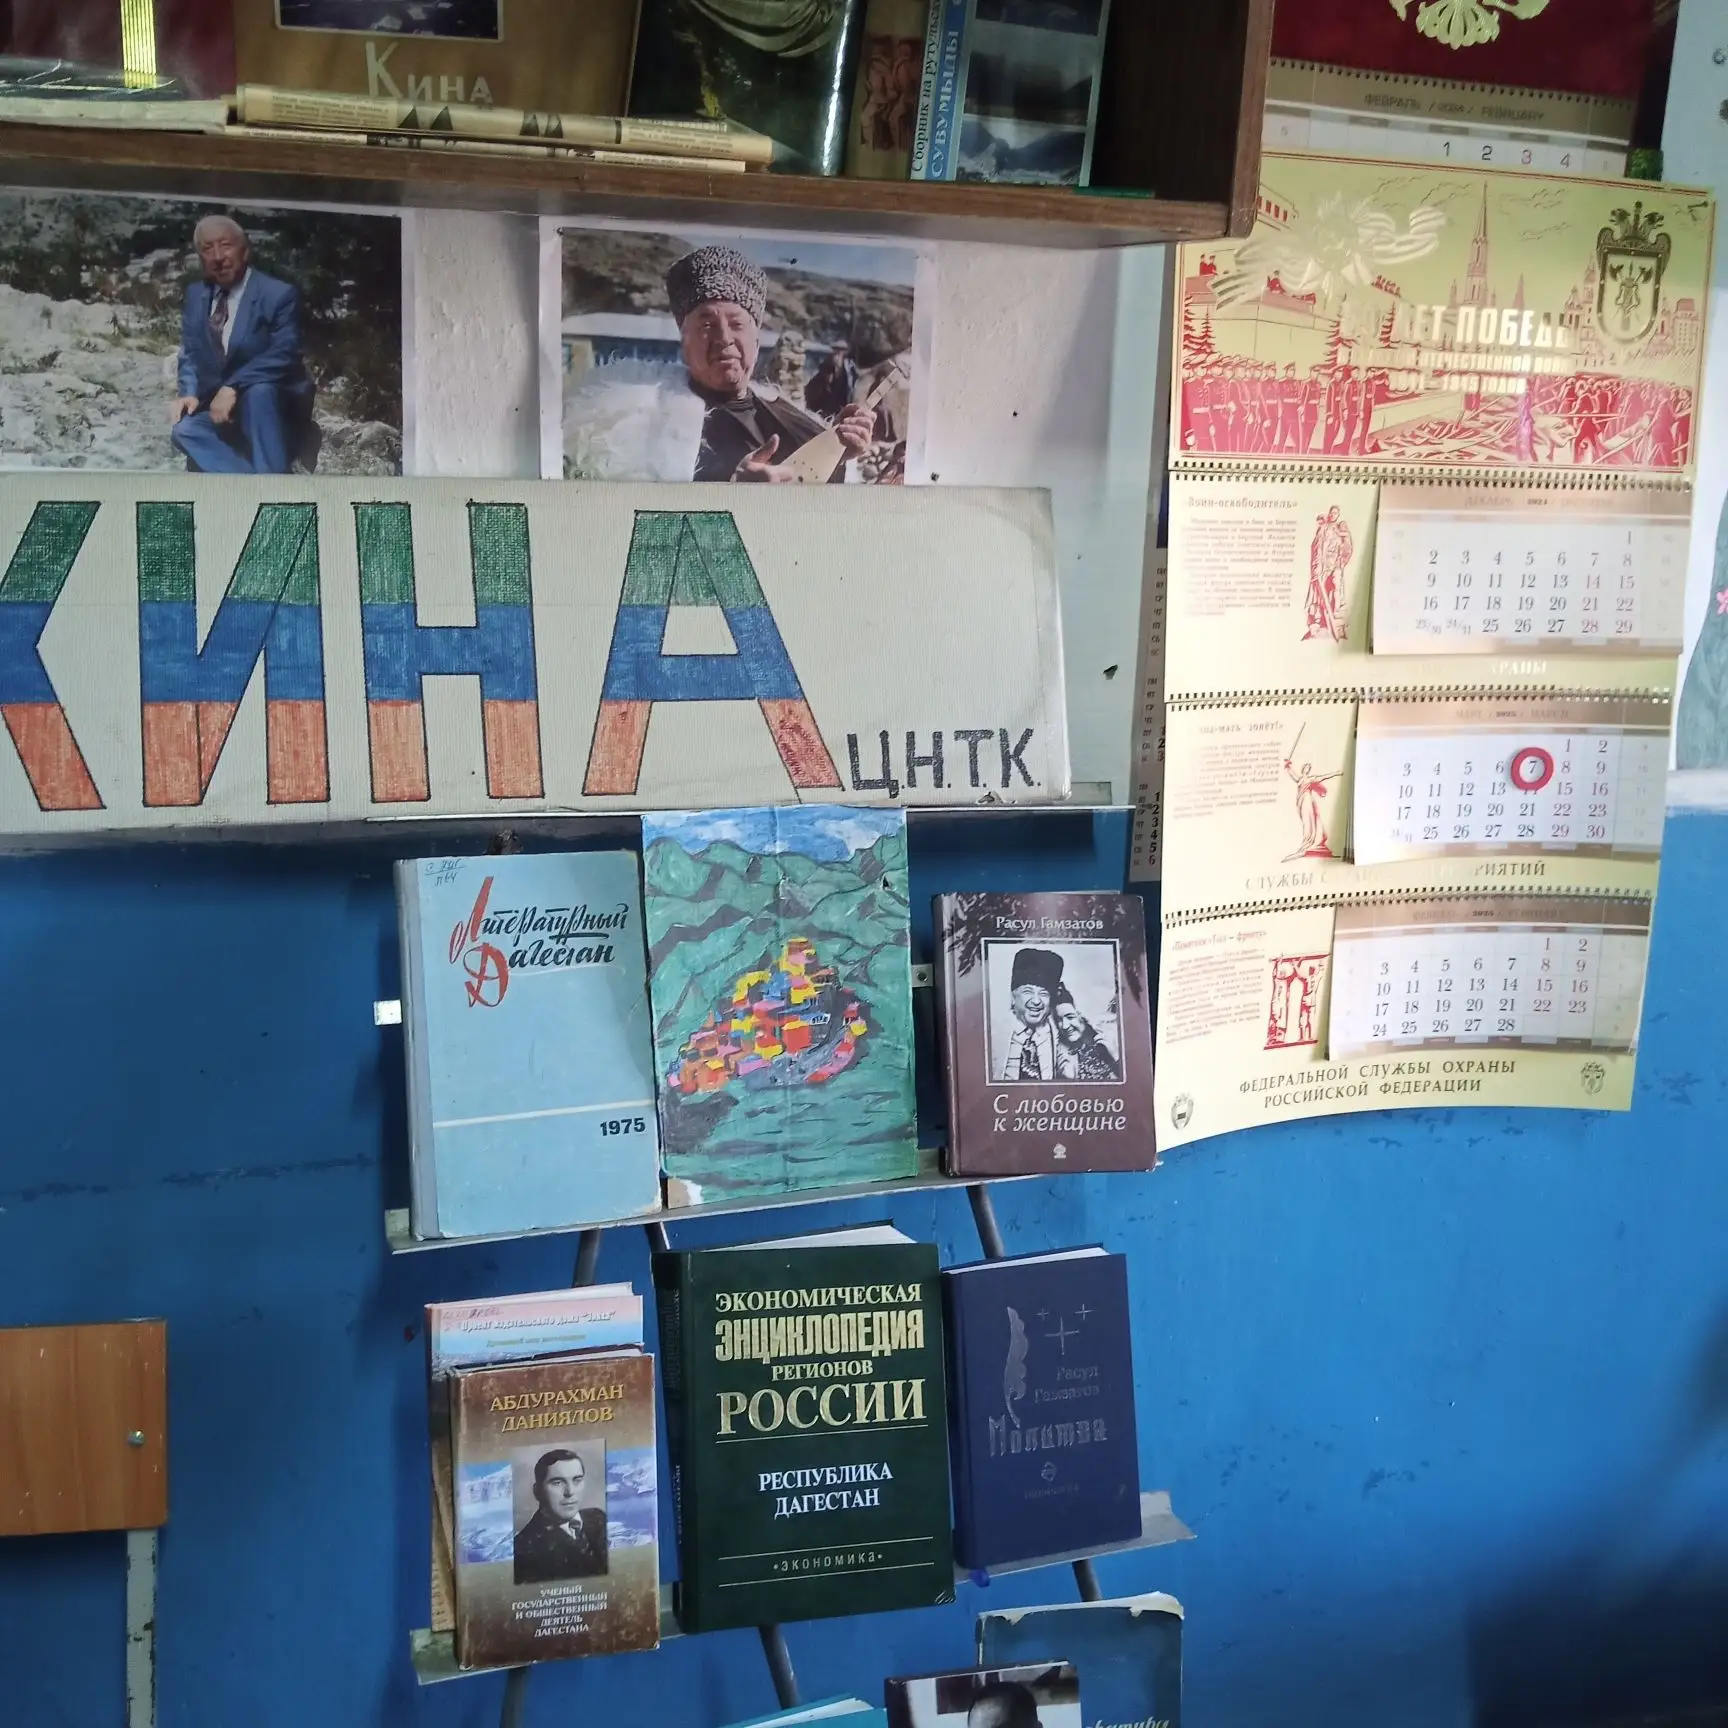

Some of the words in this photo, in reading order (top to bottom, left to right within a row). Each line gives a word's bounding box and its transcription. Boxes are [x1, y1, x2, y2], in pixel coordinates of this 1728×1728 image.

[1481, 145, 1493, 161] 2
[1521, 148, 1533, 165] 3
[1559, 153, 1570, 169] 4
[1428, 550, 1439, 565] 2
[1460, 549, 1470, 565] 3
[1493, 551, 1502, 566] 4
[1525, 551, 1535, 566] 5
[1557, 551, 1567, 566] 6
[1591, 552, 1600, 567] 7
[1622, 553, 1632, 567] 8
[1427, 572, 1437, 588] 9
[1456, 572, 1473, 588] 10
[1488, 573, 1503, 589] 11
[1520, 573, 1537, 589] 12
[1553, 573, 1569, 589] 13
[1586, 574, 1601, 590] 14
[1619, 575, 1635, 590] 15
[1423, 595, 1439, 610] 16
[1455, 595, 1471, 611] 17
[1486, 595, 1502, 611] 18
[1518, 595, 1535, 611] 19
[1548, 596, 1567, 611] 20
[1582, 596, 1598, 612] 21
[1615, 597, 1634, 612] 22
[1481, 618, 1499, 633] 25
[1514, 618, 1532, 633] 26
[1547, 618, 1566, 633] 27
[1581, 619, 1599, 634] 28
[1615, 619, 1633, 634] 29
[1598, 740, 1608, 754] 2
[1403, 762, 1412, 777] 3
[1433, 762, 1441, 776] 4
[1463, 760, 1473, 776] 5
[1495, 760, 1505, 775] 6
[1528, 760, 1538, 775] 7
[1561, 760, 1571, 774] 8
[1596, 760, 1606, 774] 9
[1399, 784, 1414, 799] 10
[1428, 783, 1442, 798] 11
[1459, 782, 1475, 797] 12
[1490, 781, 1507, 797] 13
[1557, 781, 1574, 796] 15
[1592, 781, 1609, 797] 16
[1152, 804, 1160, 815] 2
[1397, 806, 1412, 821] 17
[1426, 804, 1441, 819] 18
[1456, 803, 1473, 818] 19
[1487, 802, 1505, 817] 20
[1519, 802, 1535, 817] 21
[1552, 803, 1572, 817] 22
[1587, 803, 1607, 818] 23
[1151, 817, 1159, 828] 3
[1422, 825, 1439, 840] 25
[1452, 824, 1470, 839] 26
[1484, 824, 1503, 838] 27
[1517, 823, 1535, 838] 28
[1551, 823, 1570, 838] 29
[1587, 824, 1606, 838] 30
[1150, 829, 1158, 841] 4
[1149, 842, 1157, 854] 5
[1148, 854, 1156, 866] 6
[449, 876, 630, 964] Литературный
[996, 917, 1036, 931] Расул
[1040, 917, 1104, 930] Гамзатов
[1578, 938, 1588, 952] 2
[463, 940, 615, 1008] Дагестан
[1380, 961, 1389, 976] 3
[1410, 959, 1419, 973] 4
[1441, 958, 1451, 972] 5
[1473, 957, 1483, 971] 6
[1507, 957, 1517, 971] 7
[1540, 958, 1551, 972] 8
[1575, 959, 1587, 973] 9
[1376, 982, 1391, 997] 10
[1405, 979, 1420, 994] 11
[1437, 978, 1453, 993] 12
[1469, 977, 1485, 992] 13
[1502, 977, 1518, 992] 14
[1536, 977, 1553, 993] 15
[1572, 979, 1589, 994] 16
[1375, 1001, 1390, 1017] 17
[1403, 1000, 1420, 1014] 18
[1435, 999, 1452, 1013] 19
[1465, 998, 1484, 1012] 20
[1498, 998, 1515, 1012] 21
[1533, 999, 1552, 1013] 22
[1567, 1000, 1587, 1014] 23
[1372, 1023, 1387, 1038] 24
[1401, 1020, 1418, 1035] 25
[1431, 1019, 1449, 1033] 26
[1464, 1018, 1483, 1032] 27
[1496, 1018, 1516, 1032] 28
[1239, 1064, 1349, 1094] ФЕДЕРАЛЬНОЙ
[1359, 1061, 1431, 1078] СЛУЖБЫ
[1442, 1060, 1517, 1074] ОХРАНЫ
[1264, 1083, 1368, 1108] РОССИЙСКОЙ
[1379, 1079, 1481, 1095] ФЕДЕРАЦИИ
[993, 1094, 1009, 1114] С
[1015, 1093, 1124, 1114] любовью
[599, 1117, 646, 1137] 1975
[1013, 1115, 1127, 1135] женщине
[715, 1283, 922, 1313] ЭКОНОМИЧЕСКАЯ
[715, 1309, 924, 1364] ЭНЦИКЛОПЕДИЯ
[771, 1359, 874, 1382] РЕГИОНОВ
[490, 1383, 625, 1412] АБДУРАХМАН
[716, 1378, 927, 1436] РОССИИ
[501, 1406, 614, 1433] ДАНИЯЛОВ
[759, 1462, 893, 1492] РЕСПУБЛИКА
[774, 1488, 880, 1519] ДАГЕСТАН
[511, 1592, 608, 1611] ГОСУДАРСТВЕННЫЙ
[515, 1611, 523, 1620] И
[533, 1623, 590, 1638] ДАГЕСТАНА
